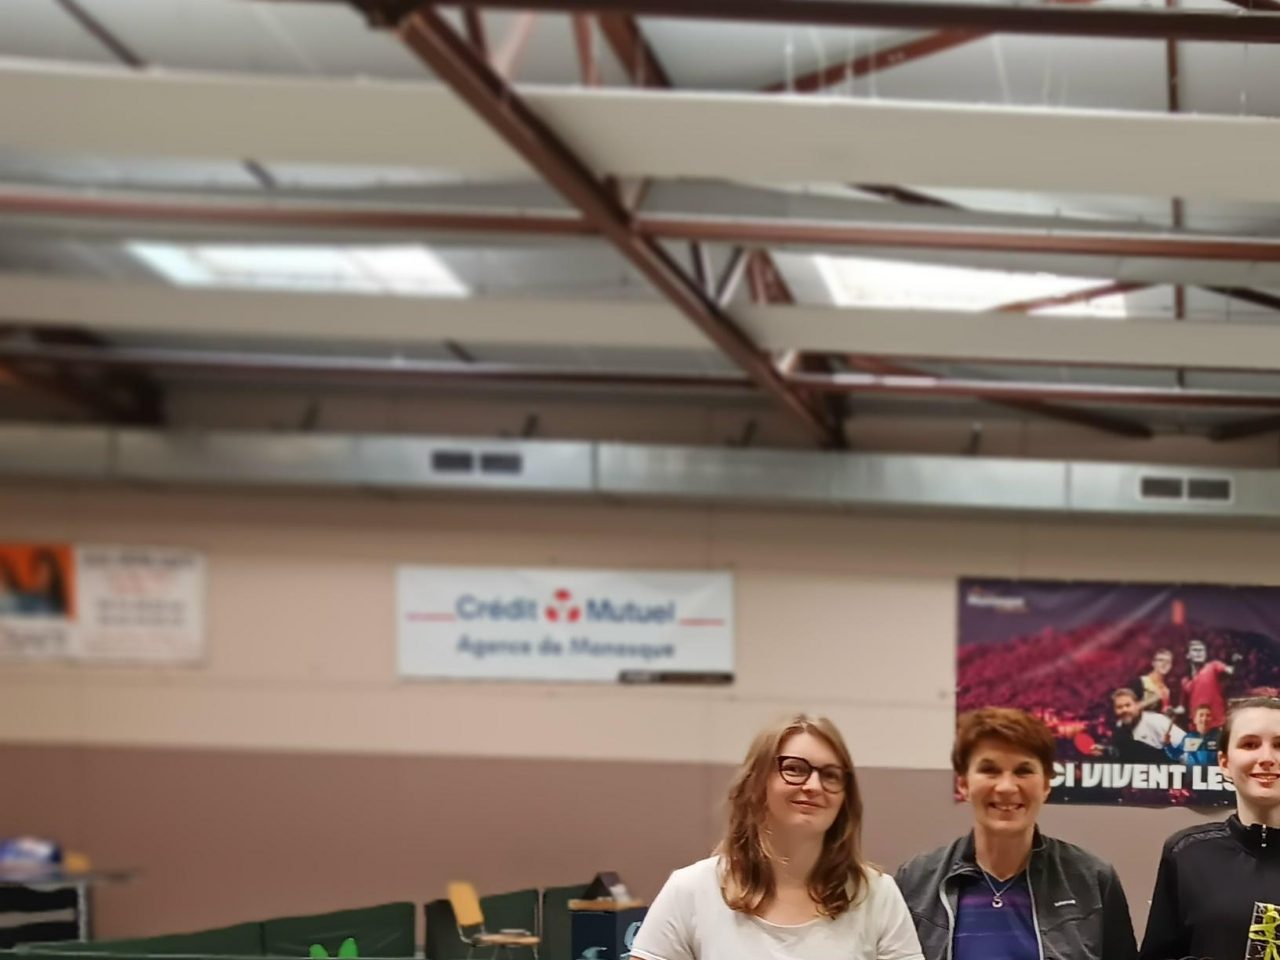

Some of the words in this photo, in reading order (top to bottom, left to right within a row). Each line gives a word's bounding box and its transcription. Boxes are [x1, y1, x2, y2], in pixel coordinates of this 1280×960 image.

[456, 594, 538, 621] Crédit
[586, 598, 676, 623] Mutuel
[457, 634, 531, 658] Agence
[1081, 763, 1187, 789] VIVENT
